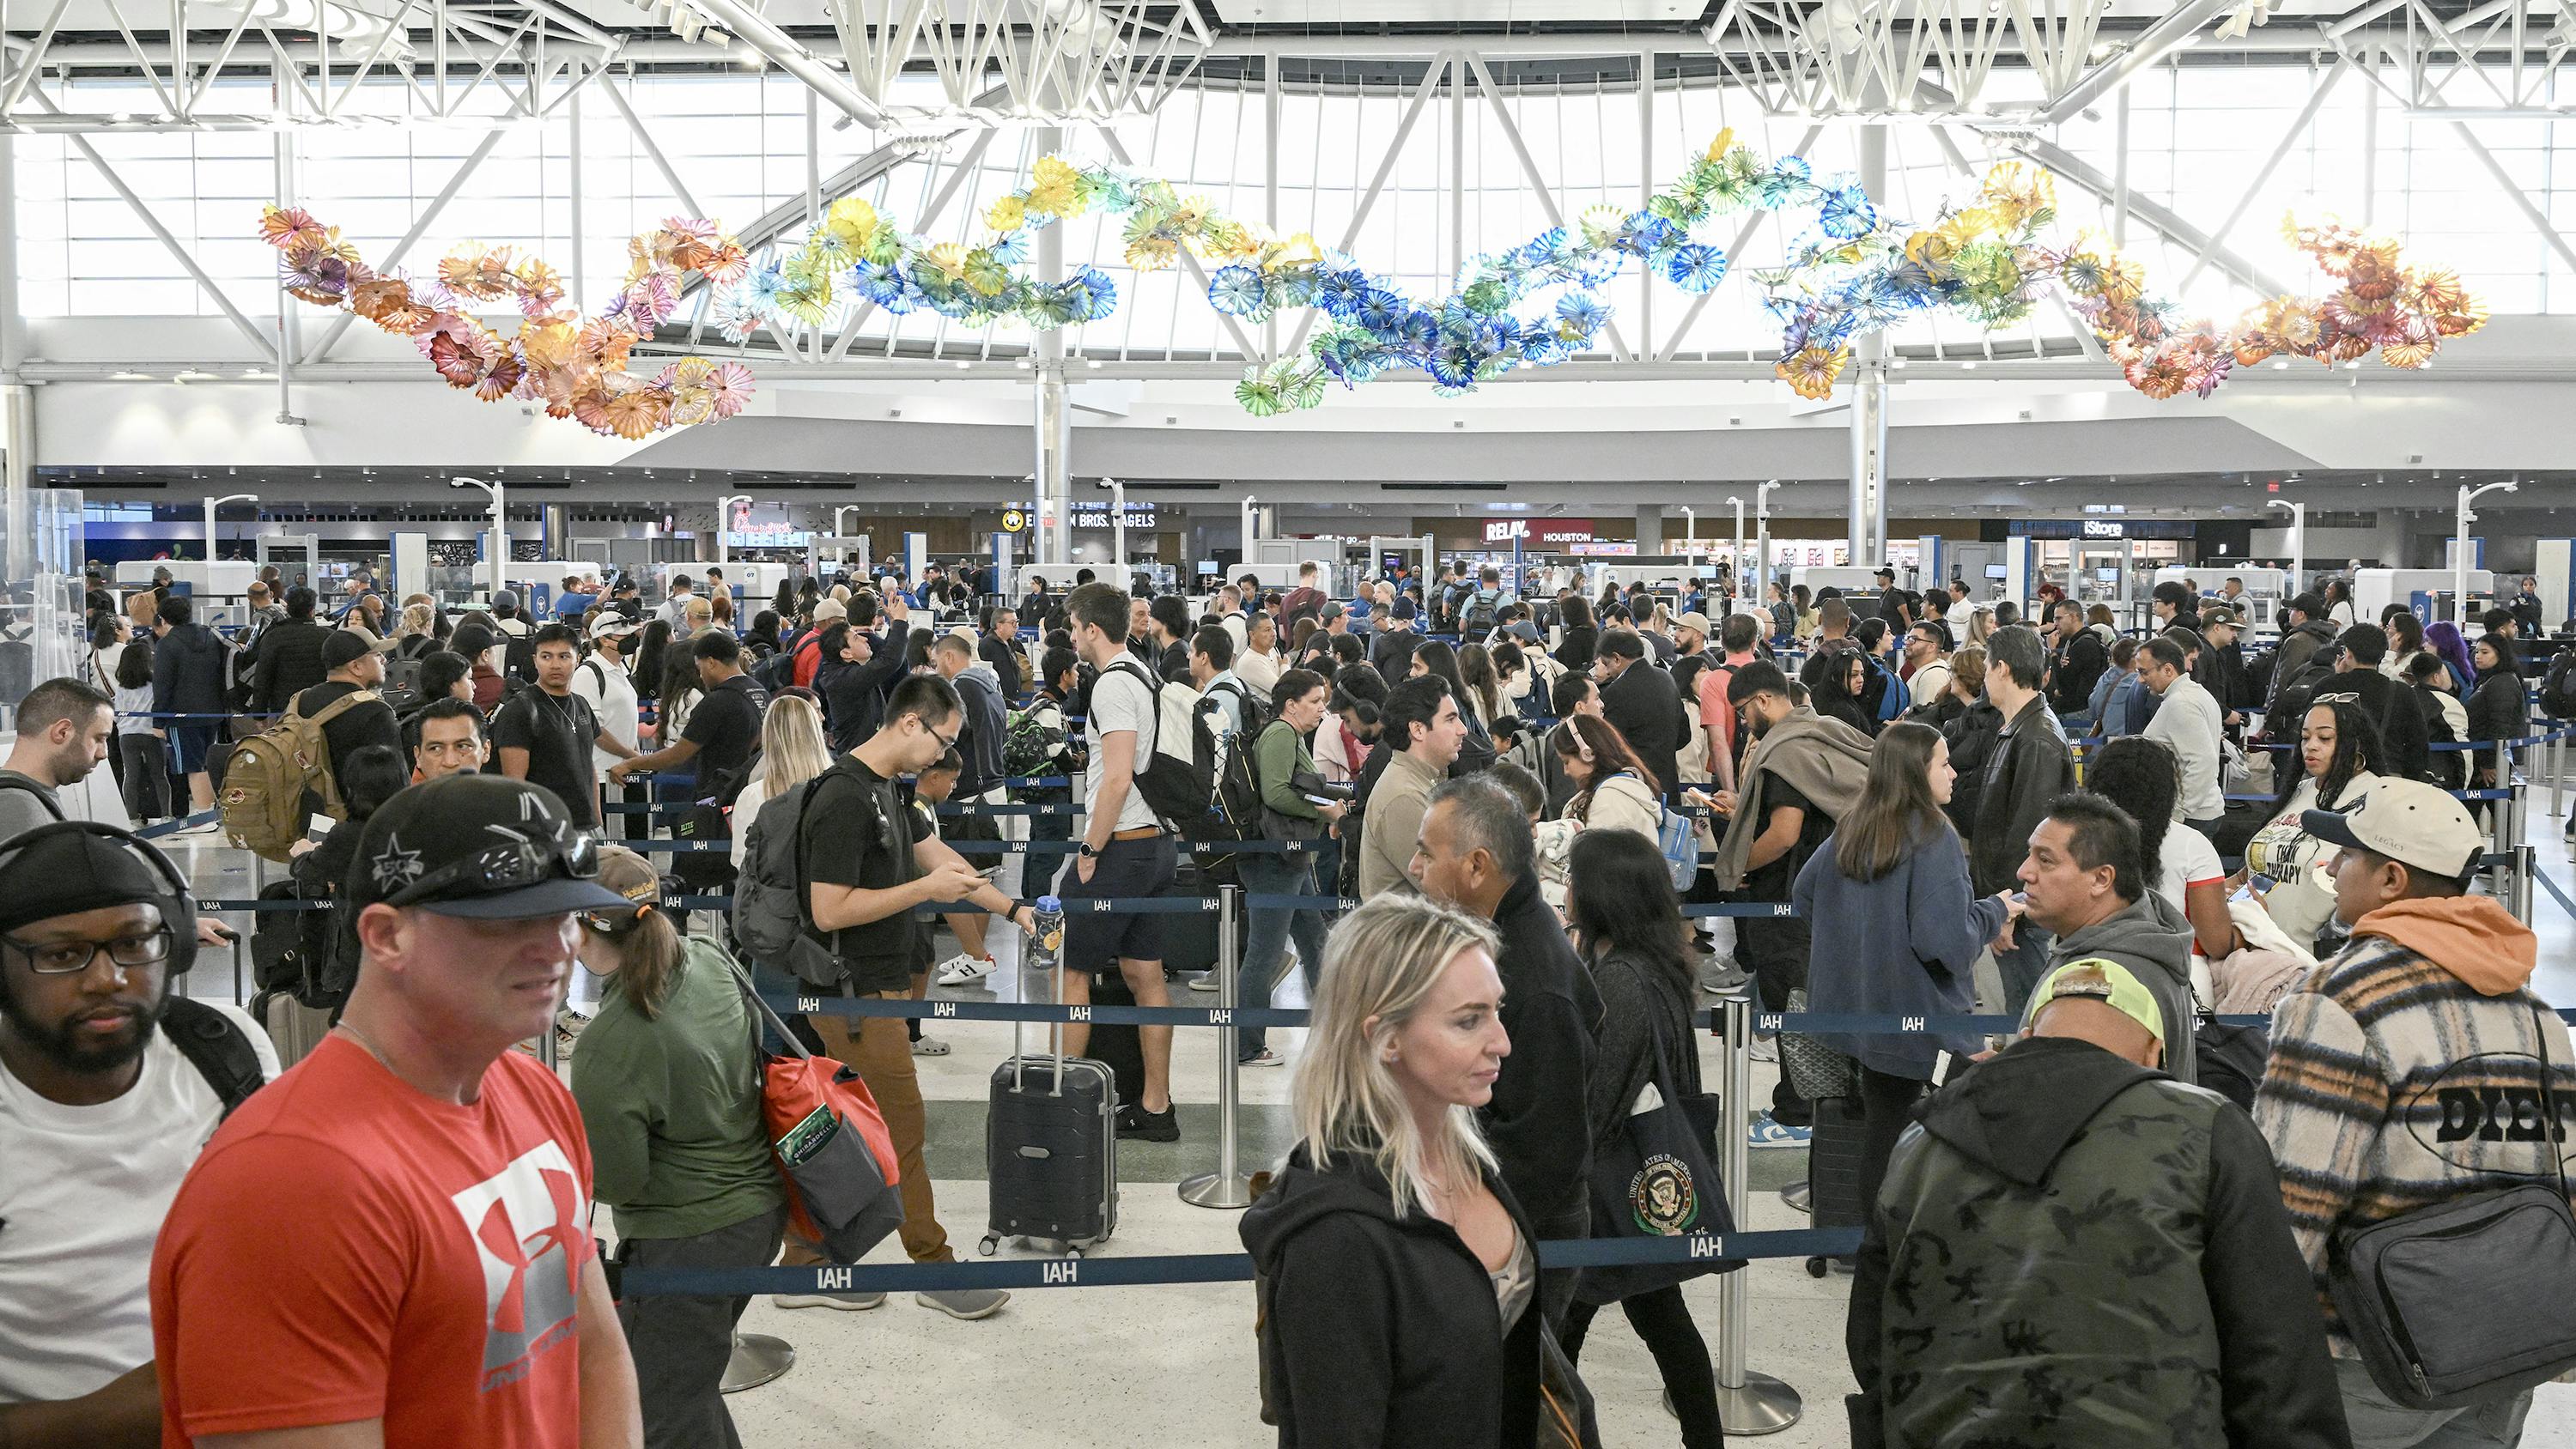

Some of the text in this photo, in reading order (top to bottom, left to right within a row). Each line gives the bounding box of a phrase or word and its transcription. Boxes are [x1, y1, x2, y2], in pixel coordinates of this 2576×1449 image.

[1079, 514, 1109, 527] BROS.
[1113, 514, 1156, 527] AGELS
[1486, 520, 1527, 542] RELAY
[2084, 521, 2123, 535] iStore
[1543, 533, 1590, 542] HOUSTON
[1026, 778, 1039, 786] IAH
[2465, 791, 2482, 799] IAH
[1697, 808, 1709, 816] IAH
[693, 841, 708, 850] IAH
[1012, 842, 1026, 852] IAH
[1195, 842, 1209, 852] IAH
[1287, 841, 1301, 850] IAH
[203, 901, 222, 911] IAH
[314, 900, 334, 910] IAH
[665, 896, 681, 907] IAH
[1094, 900, 1110, 910] IAH
[1202, 899, 1219, 909] IAH
[1774, 904, 1791, 915] IAH
[797, 997, 818, 1012] IAH
[934, 1003, 955, 1016] IAH
[1070, 1007, 1091, 1021] IAH
[1210, 1009, 1230, 1024] IAH
[1760, 1016, 1782, 1029] IAH
[1902, 1017, 1923, 1031] IAH
[793, 1124, 832, 1159] GHIRARDELLI
[1629, 1170, 1644, 1198] UNITED
[1691, 1236, 1722, 1258] IAH
[817, 1268, 852, 1289] IAH
[1042, 1263, 1077, 1284] IAH
